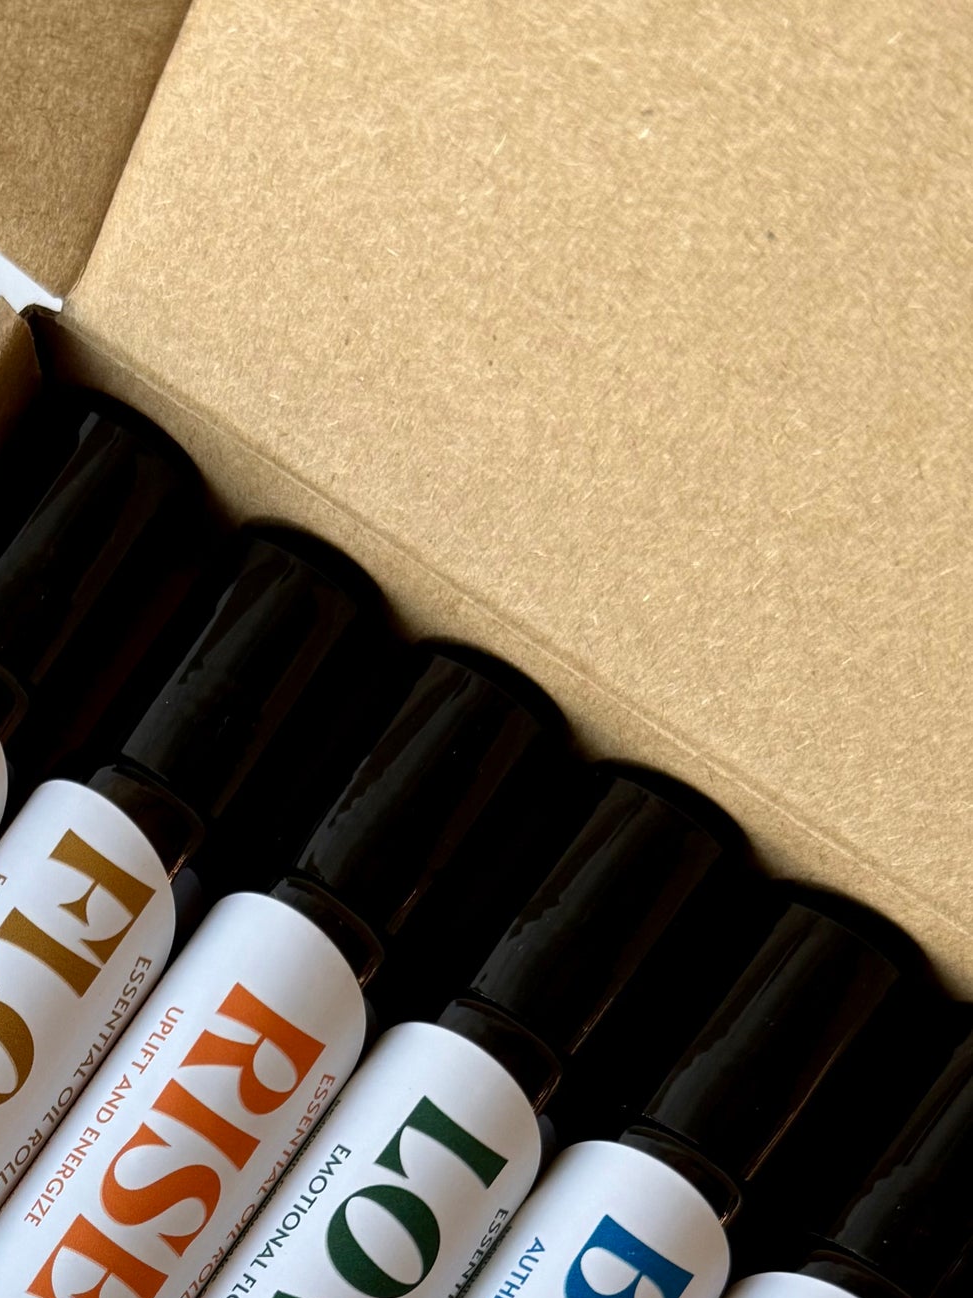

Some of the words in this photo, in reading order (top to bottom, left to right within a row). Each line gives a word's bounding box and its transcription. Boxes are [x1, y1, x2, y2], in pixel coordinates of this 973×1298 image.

[72, 955, 153, 1081] ESSENTIAL
[131, 1006, 184, 1074] UPLIFT
[42, 1083, 75, 1127] OIL
[95, 1075, 134, 1125] AND
[256, 1073, 336, 1196] ESSENTIAL
[24, 1128, 101, 1229] ENERGIZE
[257, 1143, 353, 1270] EMOTIONAL
[225, 1202, 259, 1246] OIL
